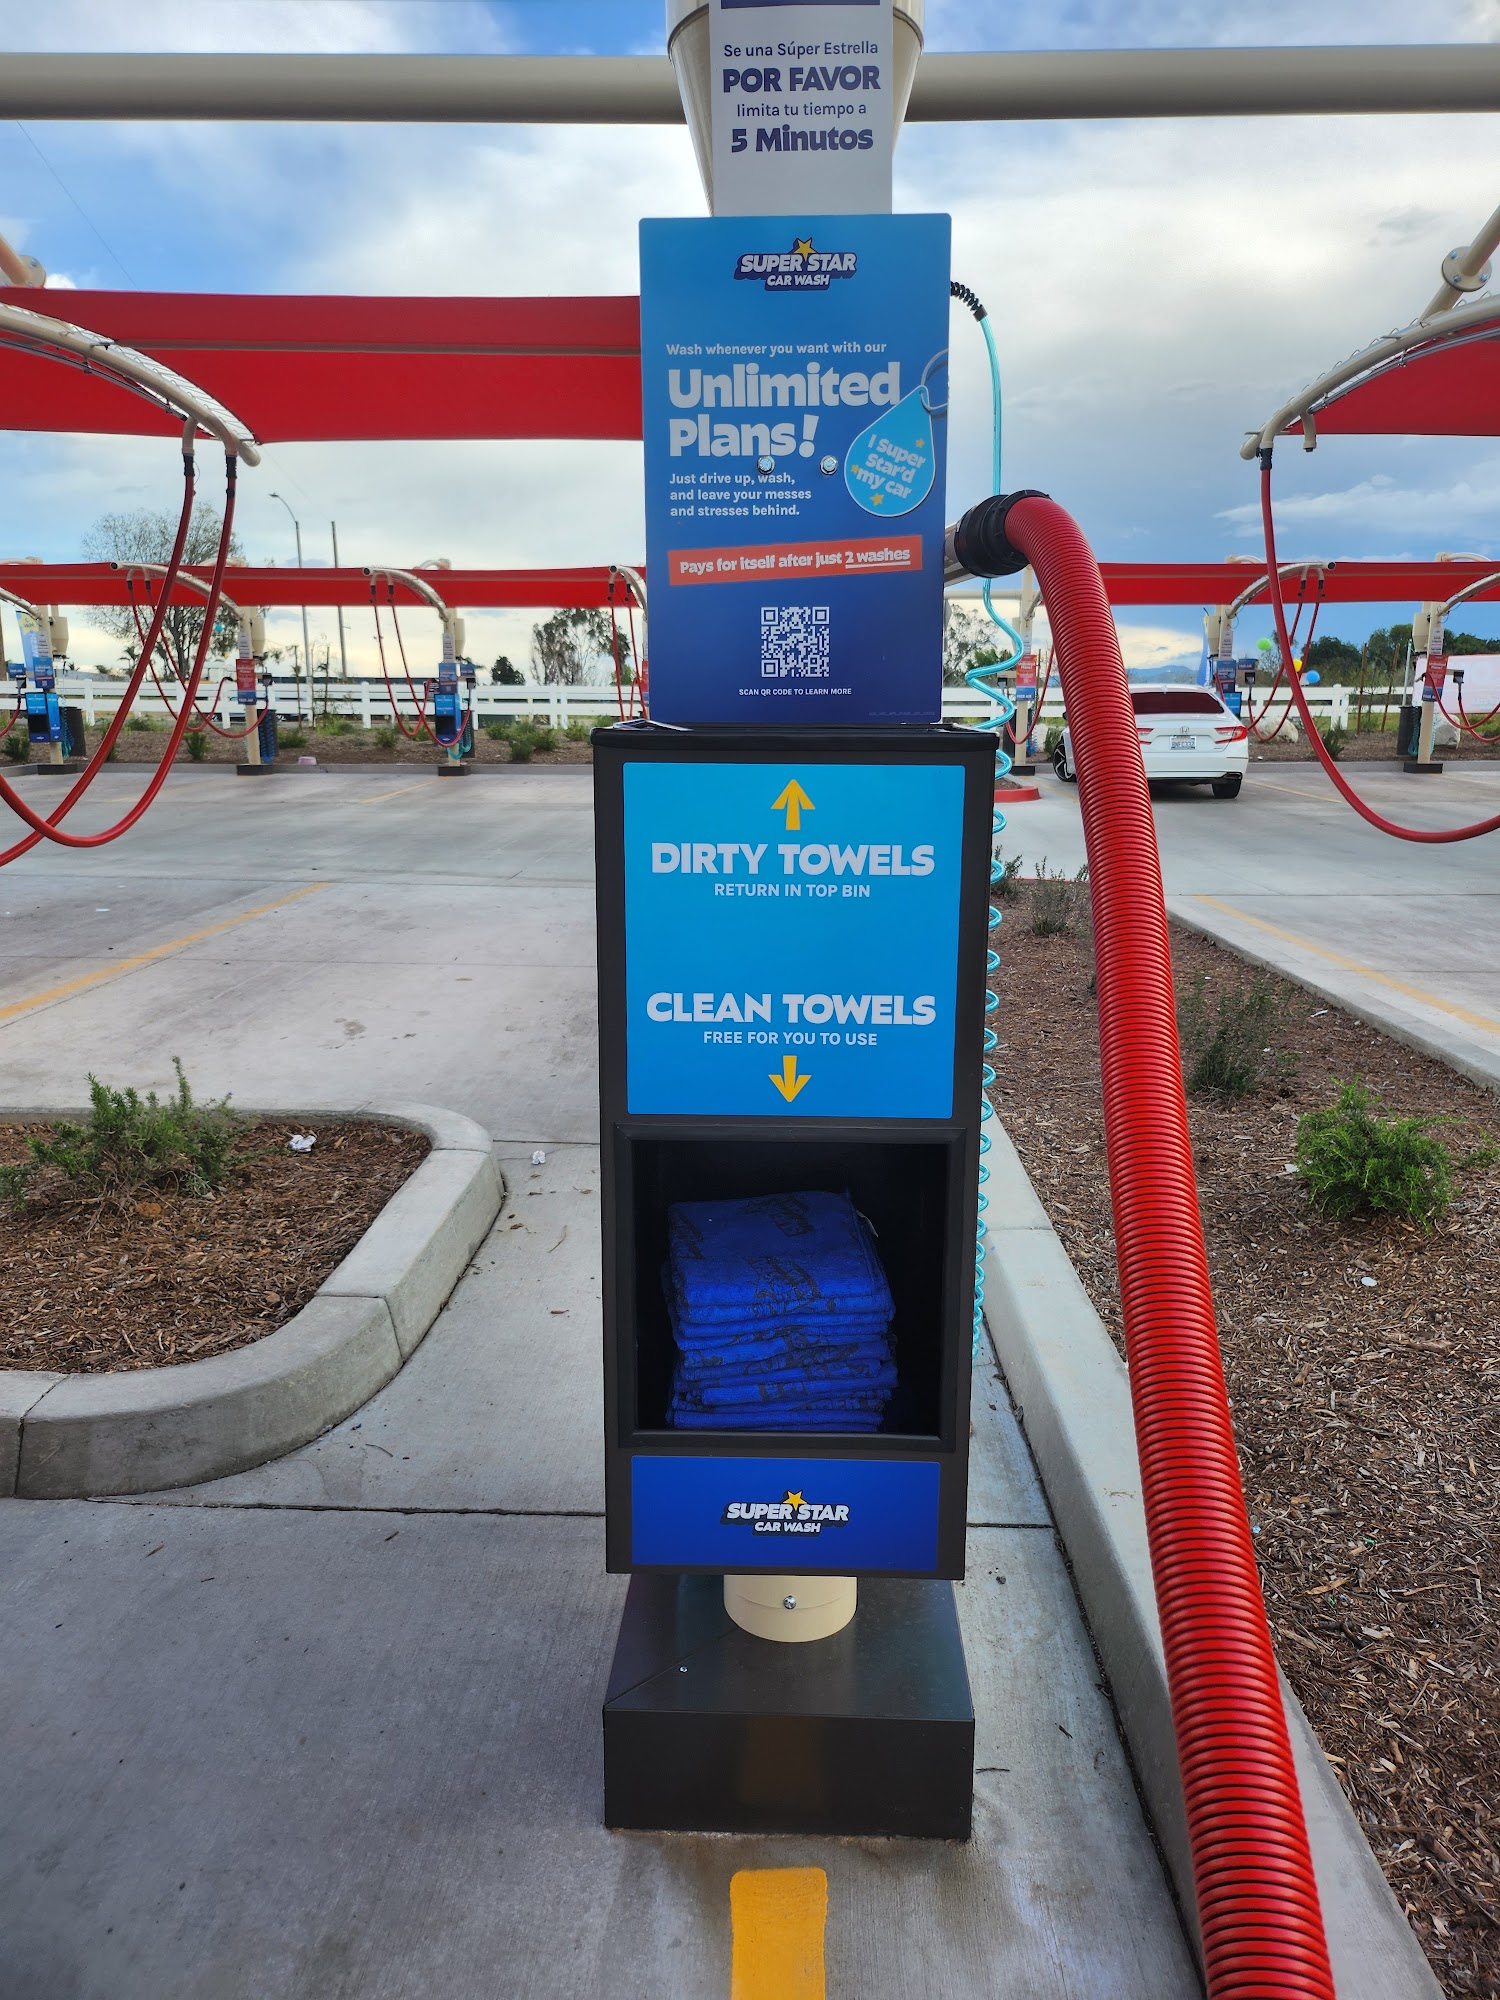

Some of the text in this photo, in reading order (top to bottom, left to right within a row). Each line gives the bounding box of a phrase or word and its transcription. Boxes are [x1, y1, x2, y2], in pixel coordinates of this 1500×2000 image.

[723, 41, 879, 59] Se una Súper Estrella
[722, 65, 881, 93] POR FAVOR
[737, 102, 867, 119] limita tu tiempo a
[731, 123, 874, 153] 5 Minutos
[740, 253, 857, 273] SUPER STAR
[767, 274, 830, 286] CAR WASH
[666, 342, 887, 357] Wash whenever you want with our
[668, 361, 901, 409] Unlimited
[669, 414, 819, 458] Plans!
[868, 434, 926, 468] I Super
[669, 472, 796, 487] Just drive up, wash,
[856, 467, 912, 499] my car
[670, 489, 812, 503] and leave your messes
[670, 504, 800, 517] and stresses behind.
[680, 547, 911, 575] Pays for itself after just 2 washes
[739, 688, 759, 696] SCAN
[760, 688, 771, 696] QR
[772, 688, 793, 696] CODE
[793, 688, 804, 696] TO
[830, 687, 852, 695] MORE
[651, 842, 936, 876] DIRTY TOWELS
[714, 883, 870, 898] RETURN IN TOP BIN
[646, 992, 937, 1026] CLEAN TOWELS
[703, 1031, 878, 1046] FREE FOR YOU TO USE
[726, 1502, 850, 1522] SUPER STAR
[754, 1521, 821, 1534] CAR WASH
